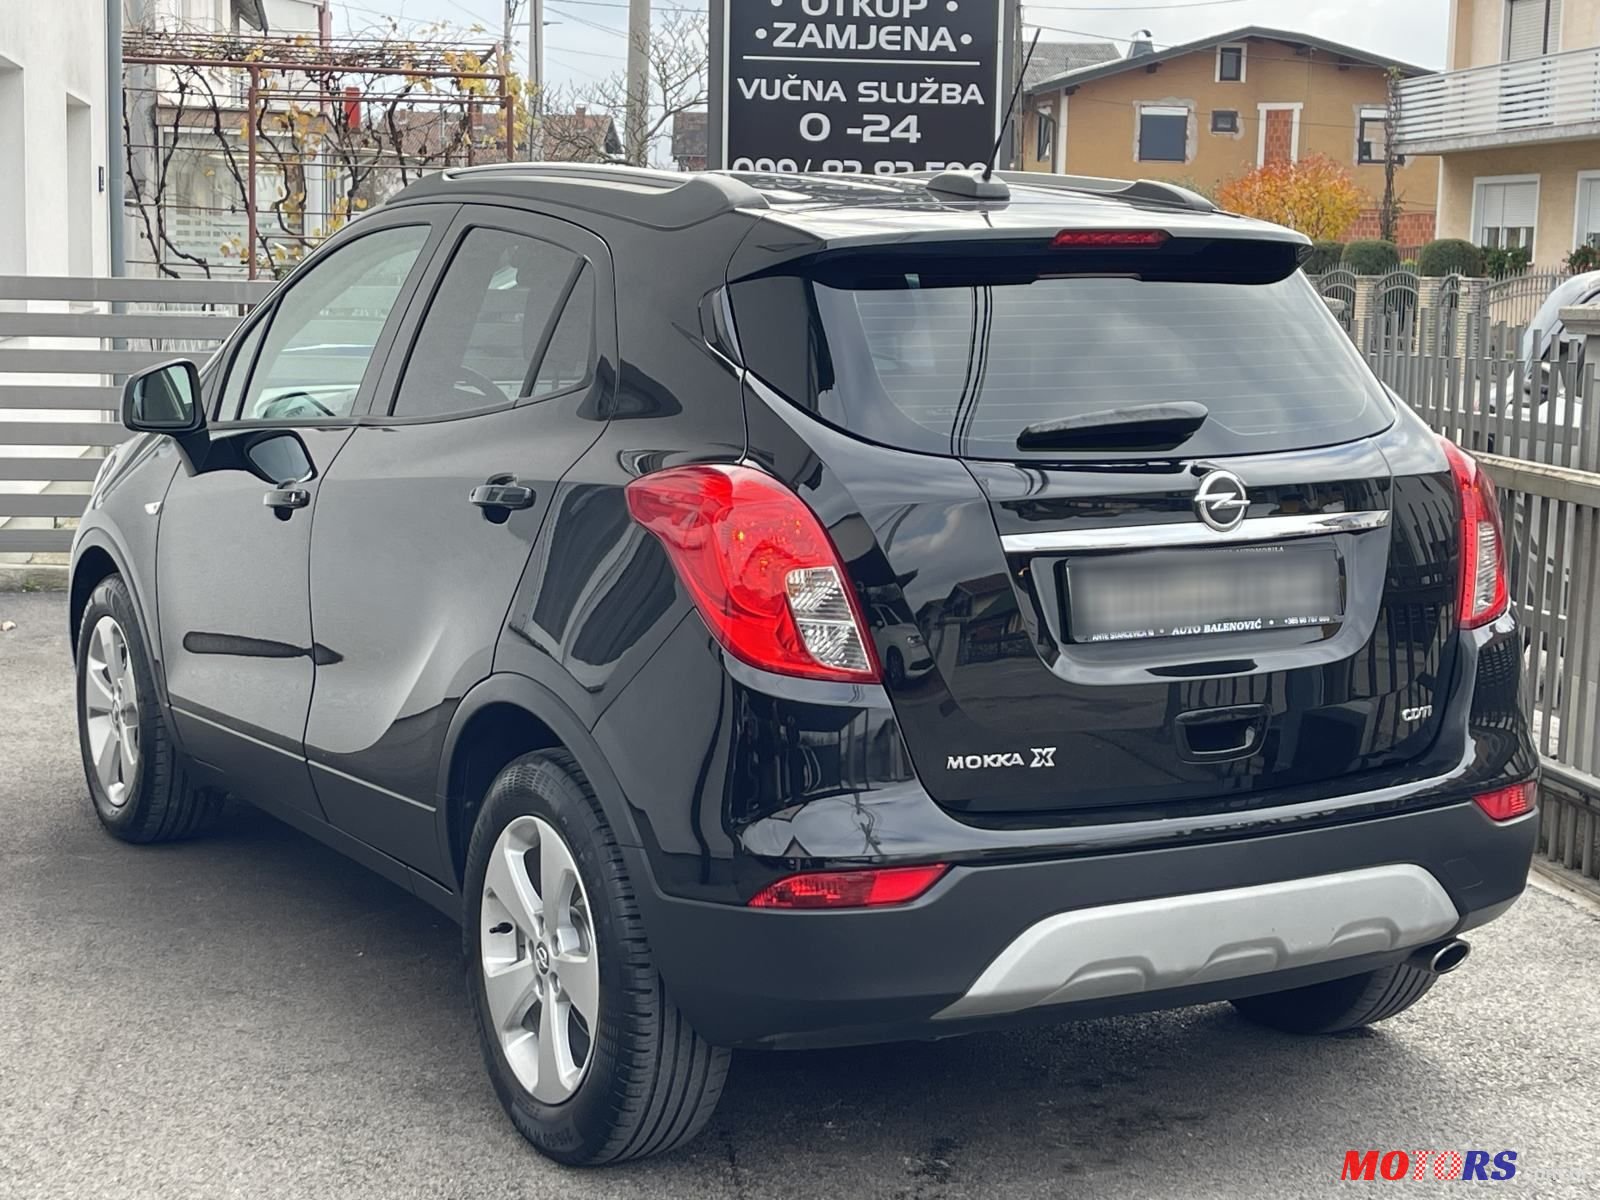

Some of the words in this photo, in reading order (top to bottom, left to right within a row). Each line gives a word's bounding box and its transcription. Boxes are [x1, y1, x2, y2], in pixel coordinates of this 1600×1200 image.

[801, 0, 928, 18] OTKUP
[772, 22, 958, 52] ZAMJENA
[737, 73, 847, 102] VUČNA
[857, 77, 985, 105] SLUŽBA
[846, 113, 922, 144] -24
[1171, 624, 1201, 636] AUTO
[1203, 617, 1262, 633] BALENOVIĆ
[946, 752, 1025, 770] MOKKA
[1029, 746, 1057, 769] X
